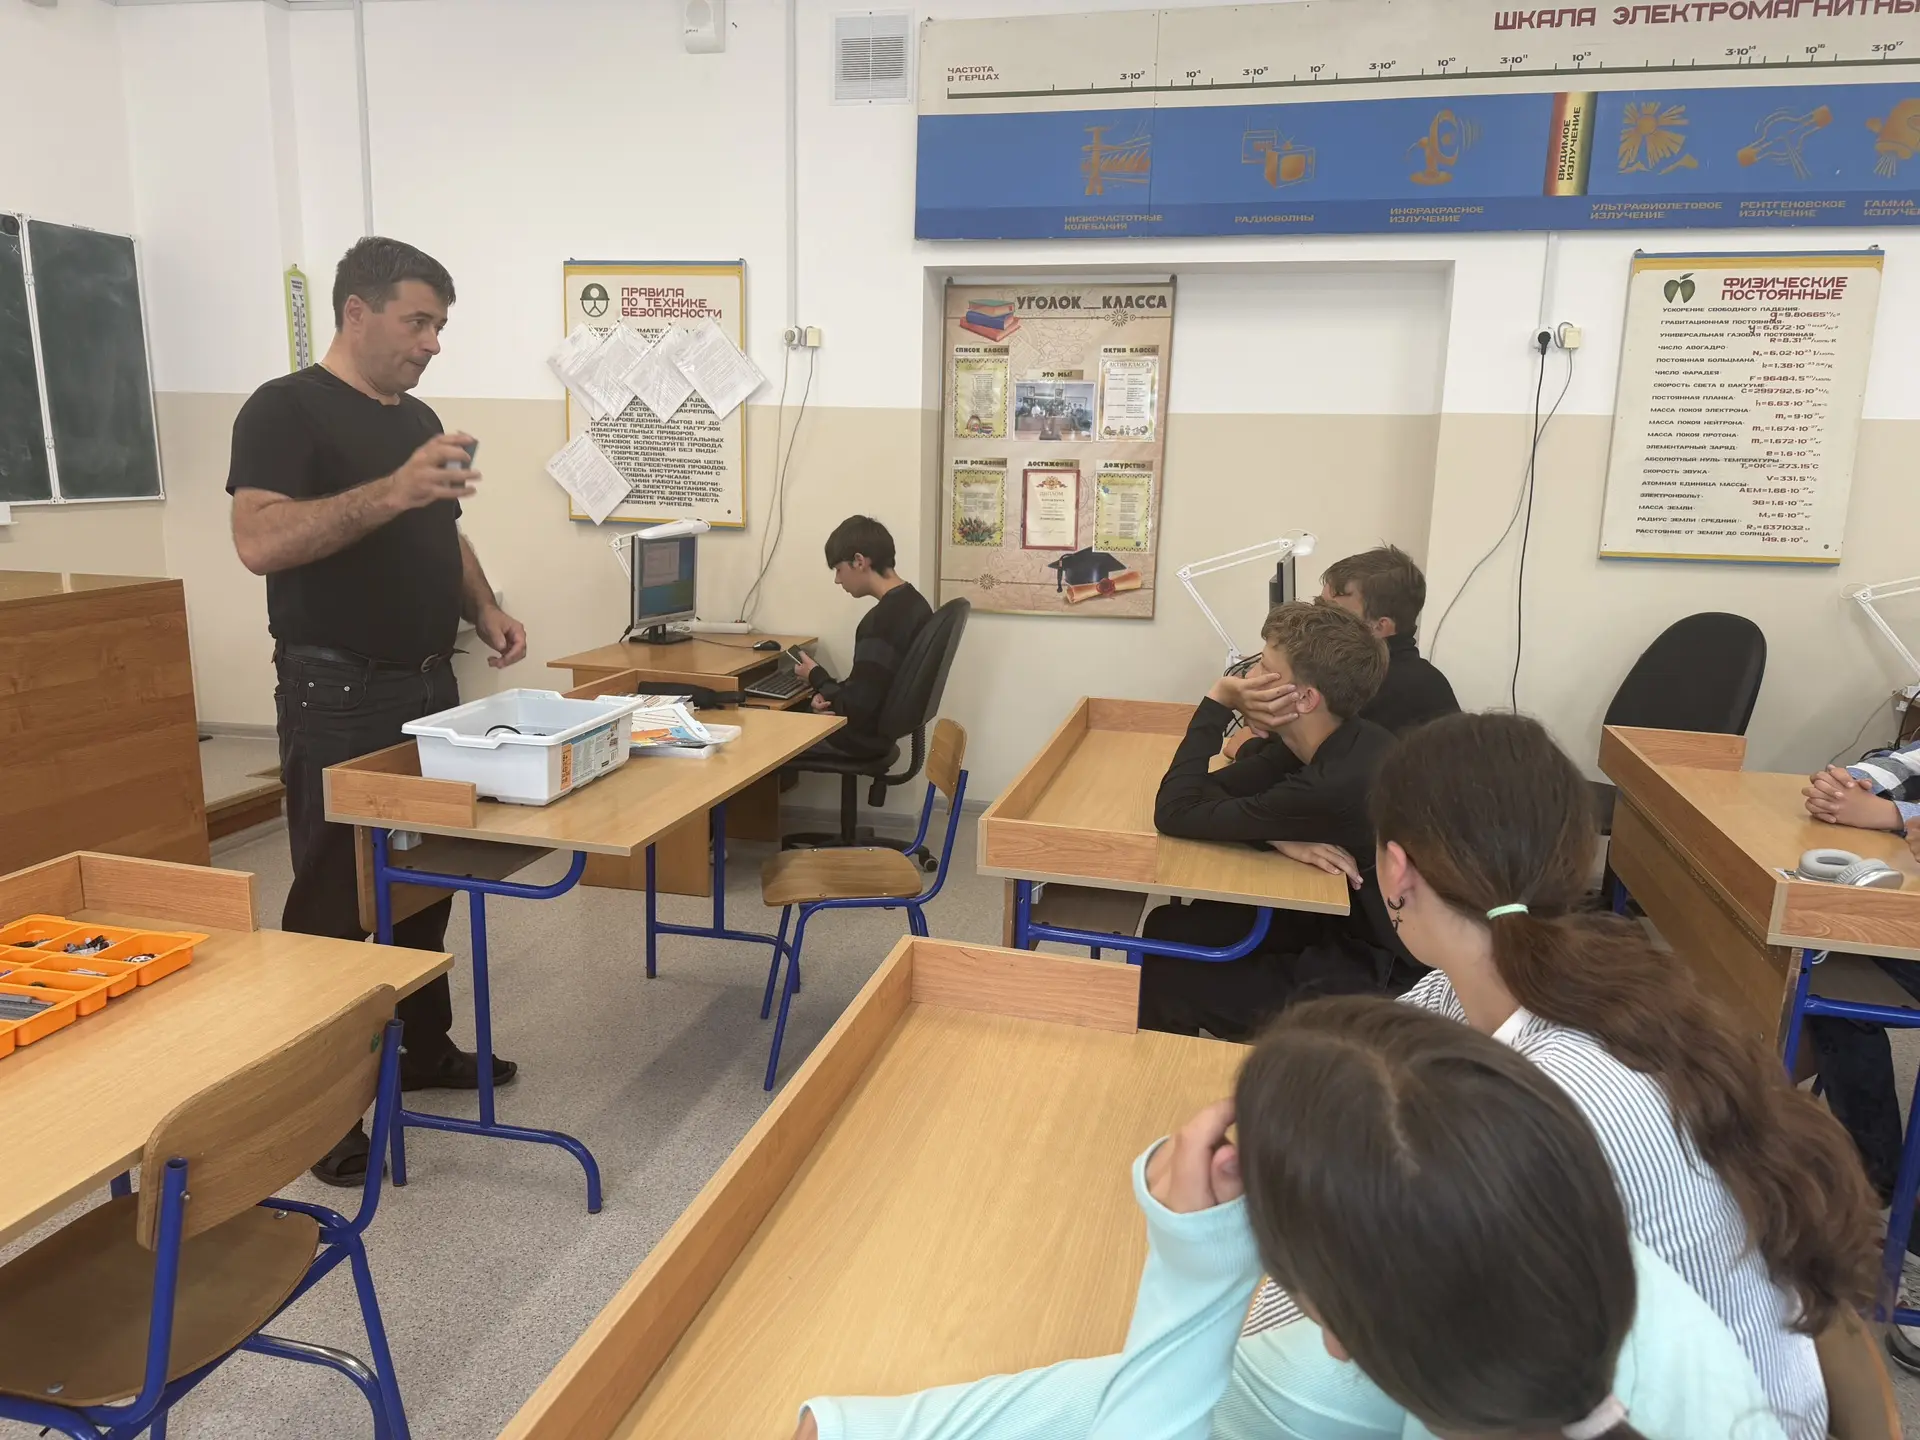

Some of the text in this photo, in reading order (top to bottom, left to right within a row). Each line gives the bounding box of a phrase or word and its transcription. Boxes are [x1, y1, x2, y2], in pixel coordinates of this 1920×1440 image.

[1494, 7, 1596, 30] ШКАЛА
[947, 65, 994, 75] ЧАСТОТА
[947, 73, 1000, 82] В ГЕРЦАХ
[1566, 106, 1581, 181] ИЗЛУЧЕНИЕ
[1557, 119, 1571, 181] ВИДИМОЕ
[1591, 201, 1723, 212] УЛЬТРАФИОЛЕТОВОЕ
[1739, 200, 1847, 209] РЕНТГЕНОВСКОЕ
[1865, 199, 1914, 207] ГАММА
[1390, 205, 1484, 215] ИНФРАКРАСНОЕ
[1590, 210, 1665, 220] ИЗЛУЧЕНИЕ
[1738, 209, 1817, 218] ИЗЛУЧЕНИЕ
[1064, 213, 1163, 224] НИЗКОЧАСТОТНЫЕ
[1234, 213, 1315, 224] РАДИОВОЛНЫ
[1389, 214, 1461, 223] ИЗЛУЧЕНИЕ
[1064, 222, 1128, 232] КОЛЕБАНИЯ
[1723, 276, 1849, 289] ФИЗИЧЕСКИЕ
[621, 287, 684, 298] ПРАВИЛА
[1721, 288, 1844, 301] ПОСТОЯННЫЕ
[621, 297, 708, 309] ПО ТЕХНИКЕ
[1016, 294, 1168, 309] УГОЛОК КЛАССА
[621, 307, 722, 319] БЕЗОПАСНОСТИ
